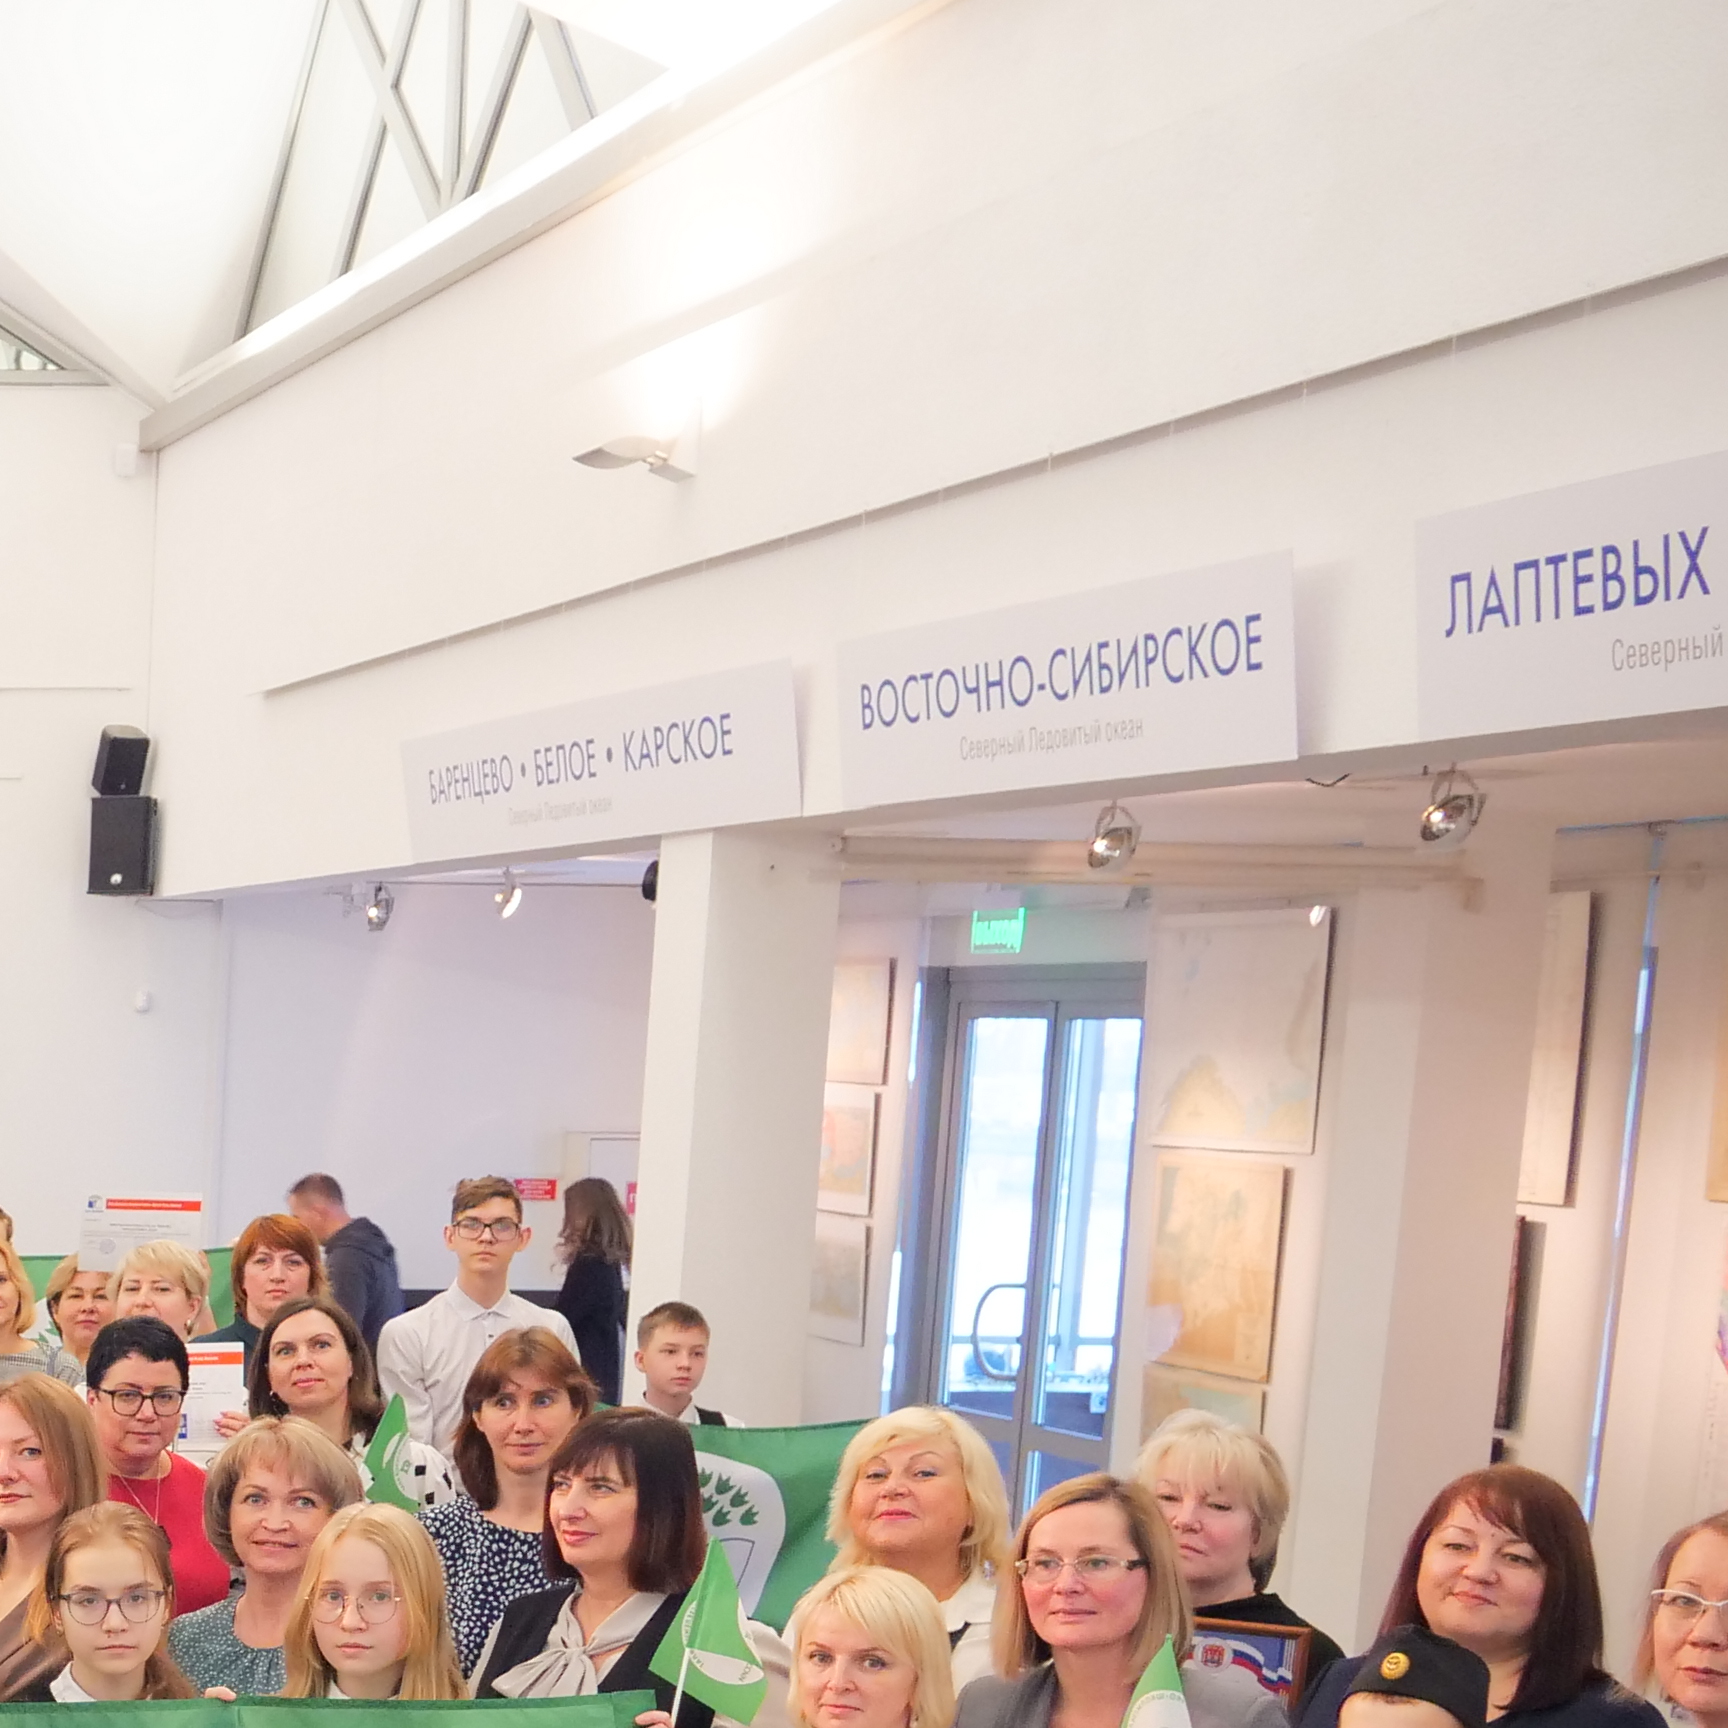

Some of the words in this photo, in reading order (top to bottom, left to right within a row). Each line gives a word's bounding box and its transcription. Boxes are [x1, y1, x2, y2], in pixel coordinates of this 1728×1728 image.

[1445, 524, 1711, 638] ЛАПТЕВЫХ
[859, 612, 1264, 730] ВОСТОЧНО-СИБИРСКОЕ
[1612, 624, 1724, 672] Северный
[428, 754, 513, 804] БАРЕНЦЕВО
[533, 737, 597, 787] БЕЛОЕ
[622, 712, 734, 772] КАРСКОЕ
[960, 729, 1025, 761] Северный
[1029, 720, 1101, 756] Ледовитый
[1106, 718, 1144, 741] океан
